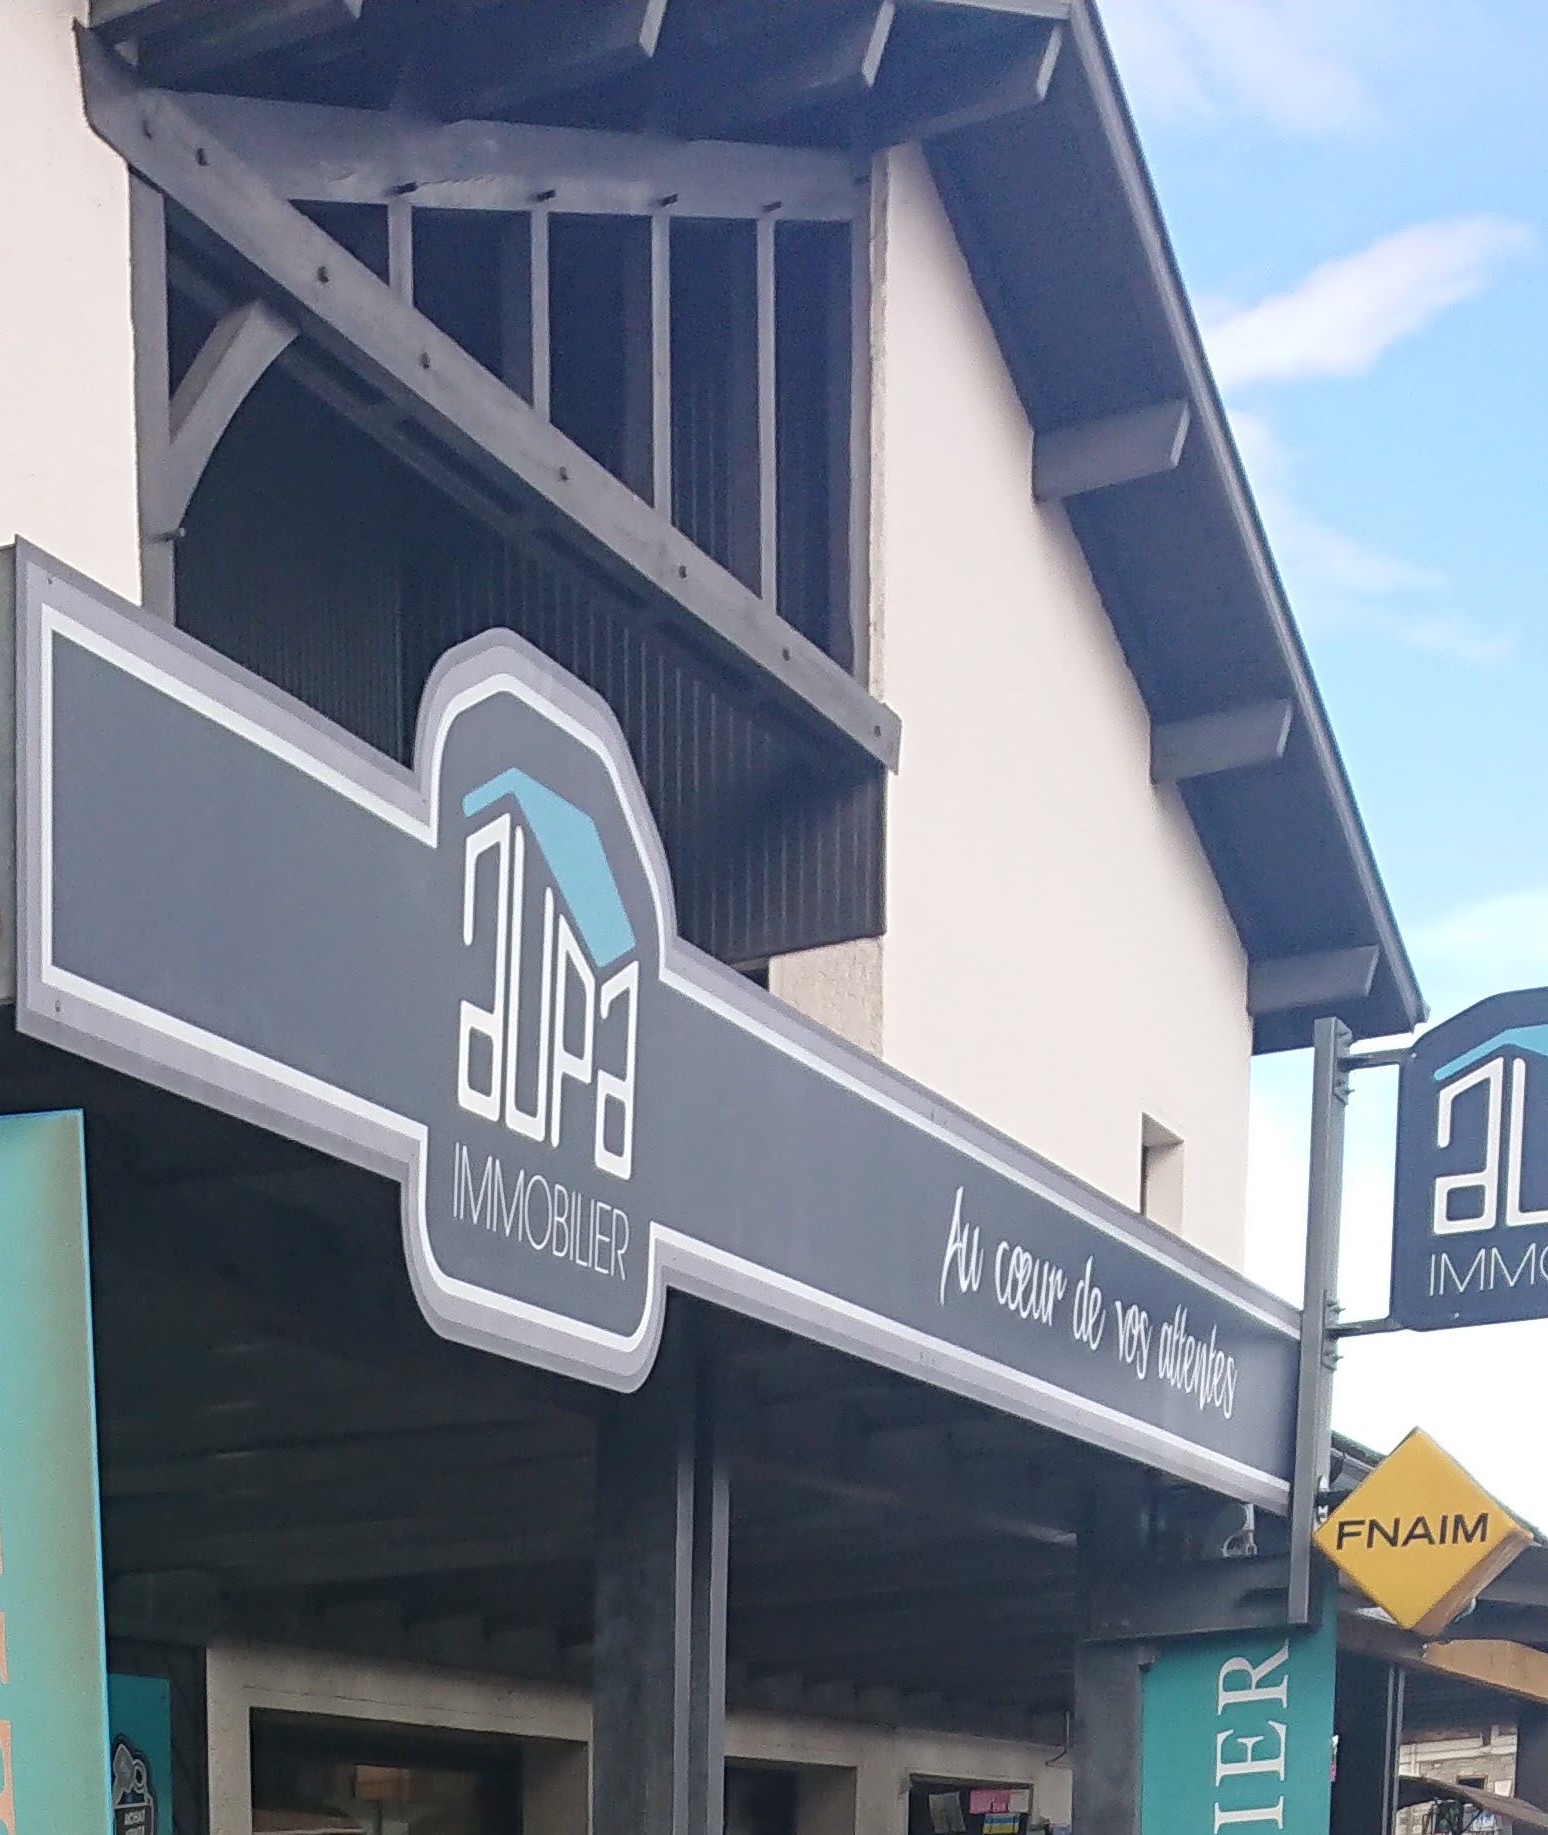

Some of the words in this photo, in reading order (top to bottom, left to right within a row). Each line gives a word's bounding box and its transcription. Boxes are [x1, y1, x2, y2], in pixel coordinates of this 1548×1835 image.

[453, 1142, 629, 1281] IMMOBILIER
[940, 1186, 983, 1306] Au
[1073, 1254, 1105, 1352] de
[1114, 1299, 1153, 1381] vos
[1158, 1302, 1237, 1420] attentes
[1429, 1242, 1548, 1297] IMM
[1334, 1510, 1490, 1551] FNAIM
